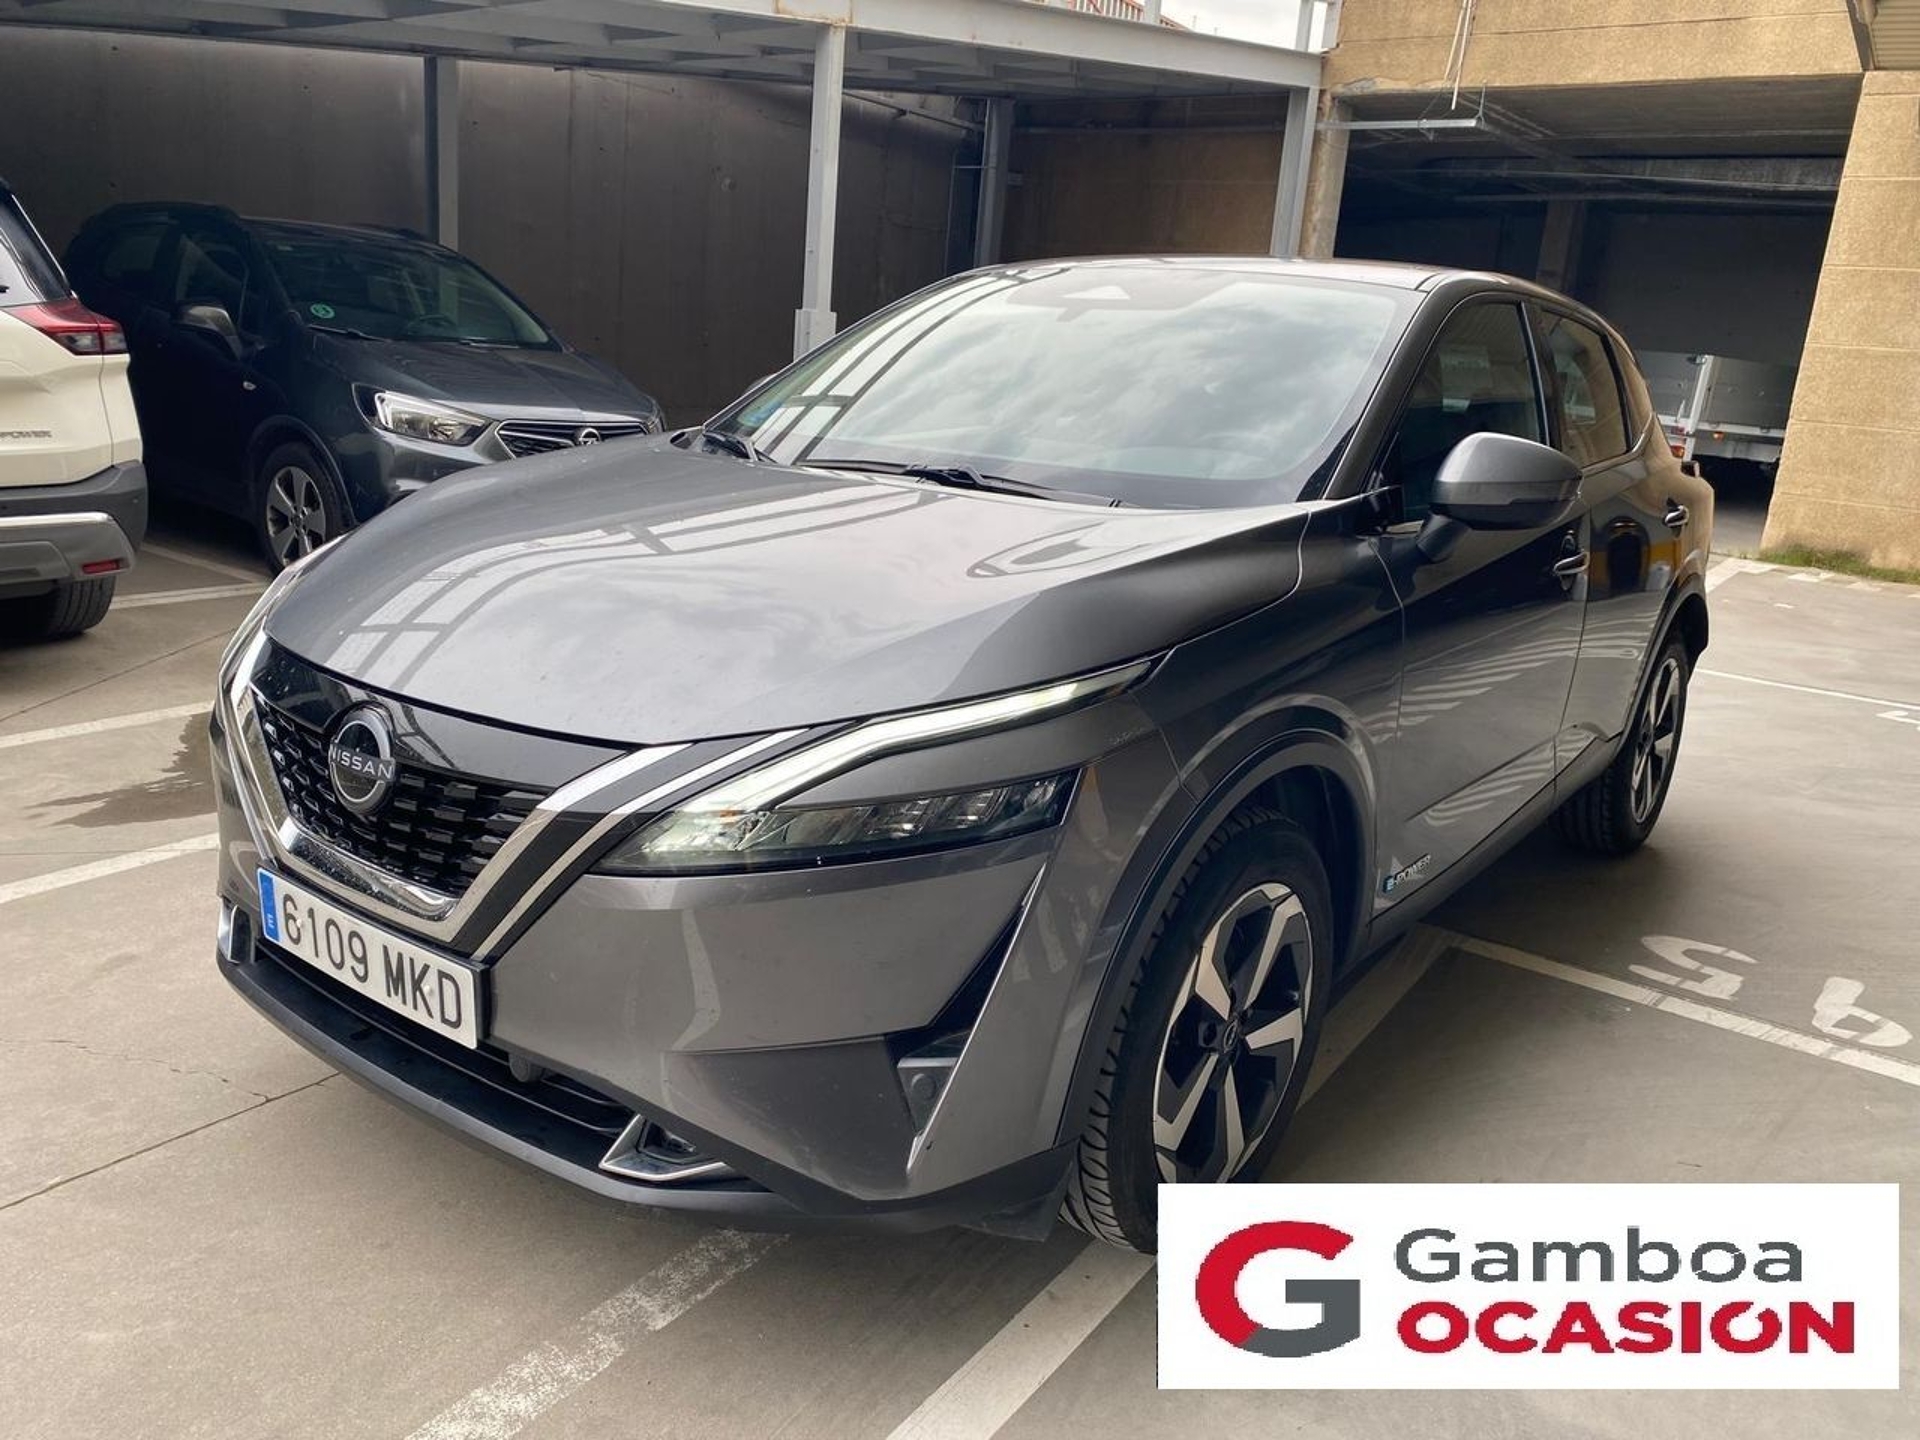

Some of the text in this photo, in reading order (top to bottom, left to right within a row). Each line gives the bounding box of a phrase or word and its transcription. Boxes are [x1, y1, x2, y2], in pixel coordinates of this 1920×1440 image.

[330, 745, 394, 779] NISSAN
[282, 893, 463, 1030] 6109 MKD
